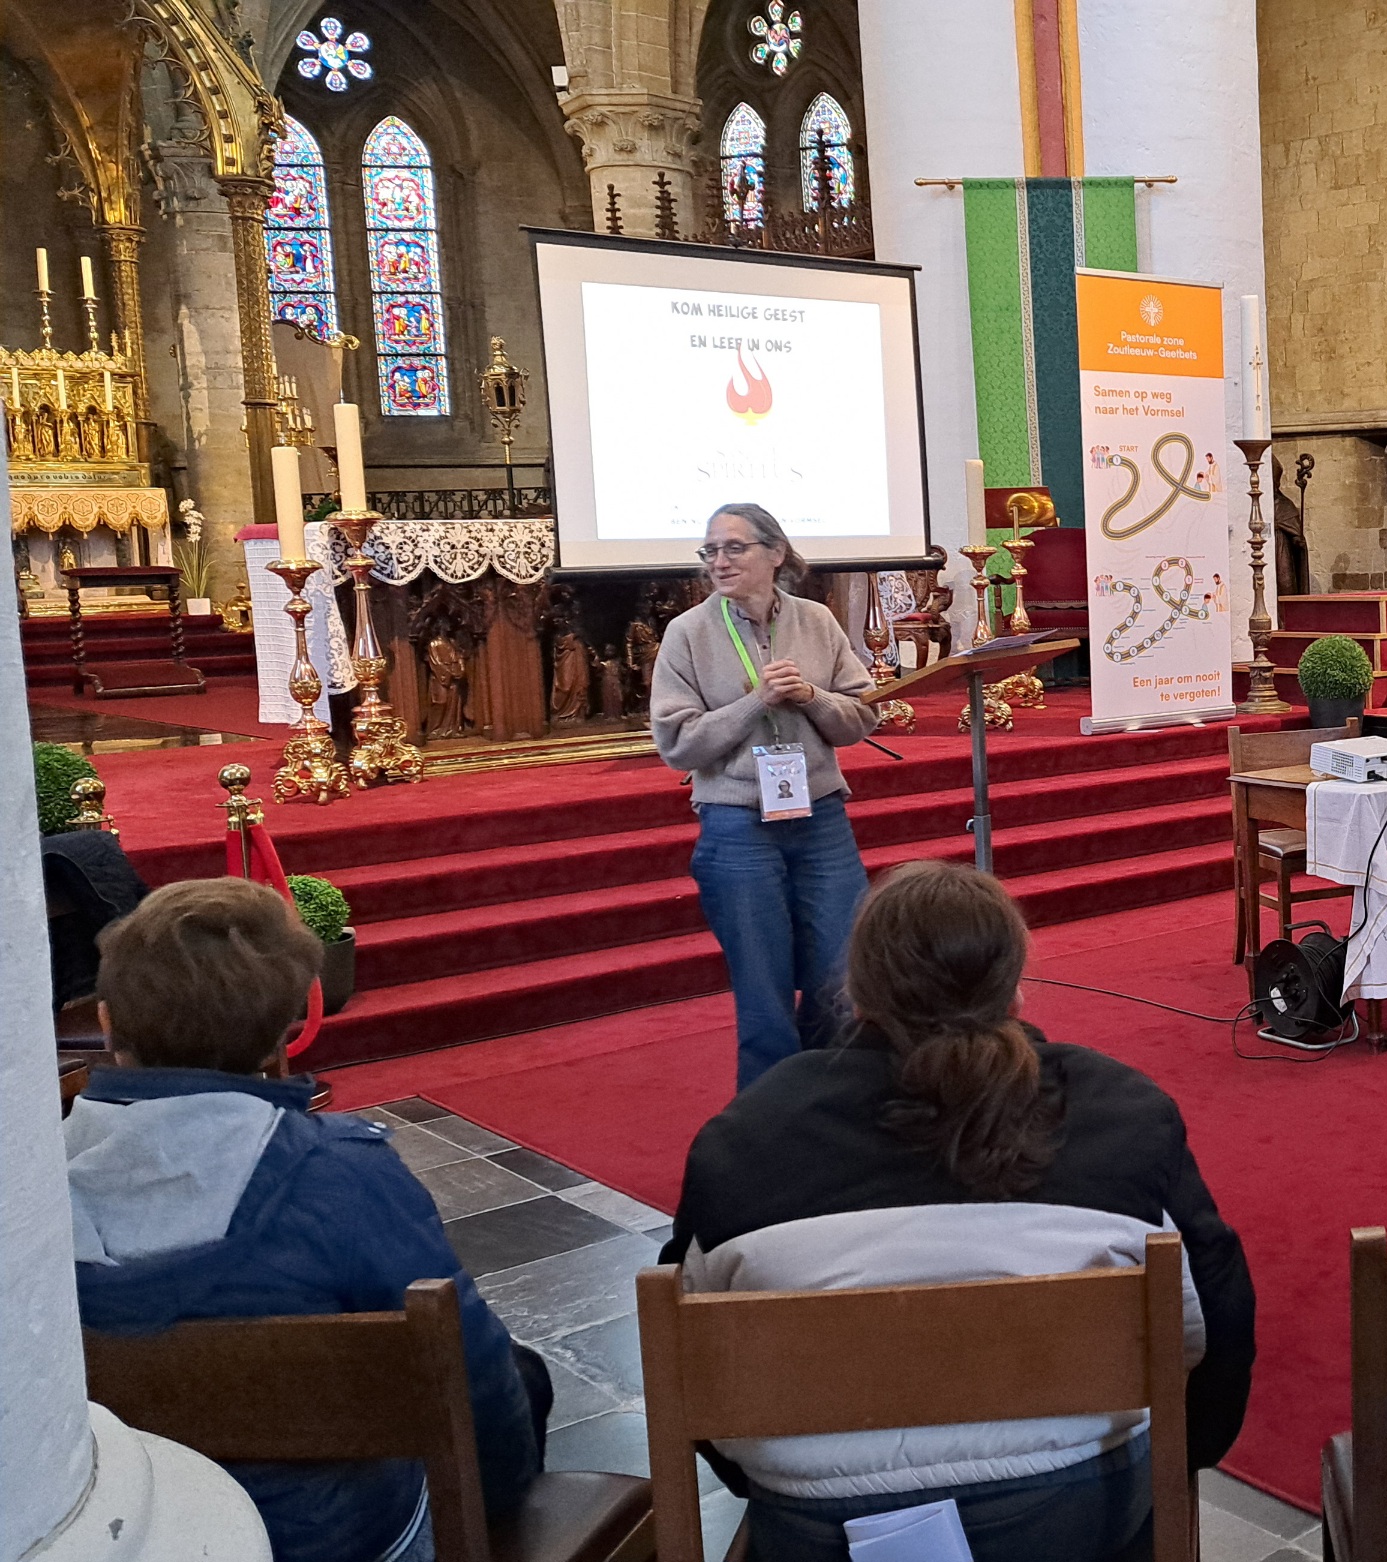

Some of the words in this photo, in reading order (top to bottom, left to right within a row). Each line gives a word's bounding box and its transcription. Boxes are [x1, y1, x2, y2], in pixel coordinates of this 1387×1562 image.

[671, 301, 703, 316] KOM
[708, 304, 758, 319] HEILIGE
[763, 308, 805, 322] GEEST
[690, 335, 707, 348] EN
[712, 336, 742, 351] LEEF
[747, 338, 760, 352] IN
[765, 339, 792, 353] ONS
[1120, 331, 1161, 344] Pastorale
[1163, 336, 1184, 346] zone
[1107, 343, 1198, 360] Zoutleeuw-Geetbets
[1093, 385, 1131, 398] Samen
[1133, 390, 1148, 402] op
[1151, 391, 1172, 403] weg
[1094, 405, 1119, 415] naar
[1122, 404, 1139, 416] het
[1142, 405, 1185, 418] Vormsel
[1133, 677, 1152, 688] Een
[1154, 675, 1174, 689] jaar
[1177, 675, 1192, 684] om
[1195, 670, 1220, 682] nooit
[1160, 691, 1170, 701] te
[1173, 686, 1220, 702] vergeten!
